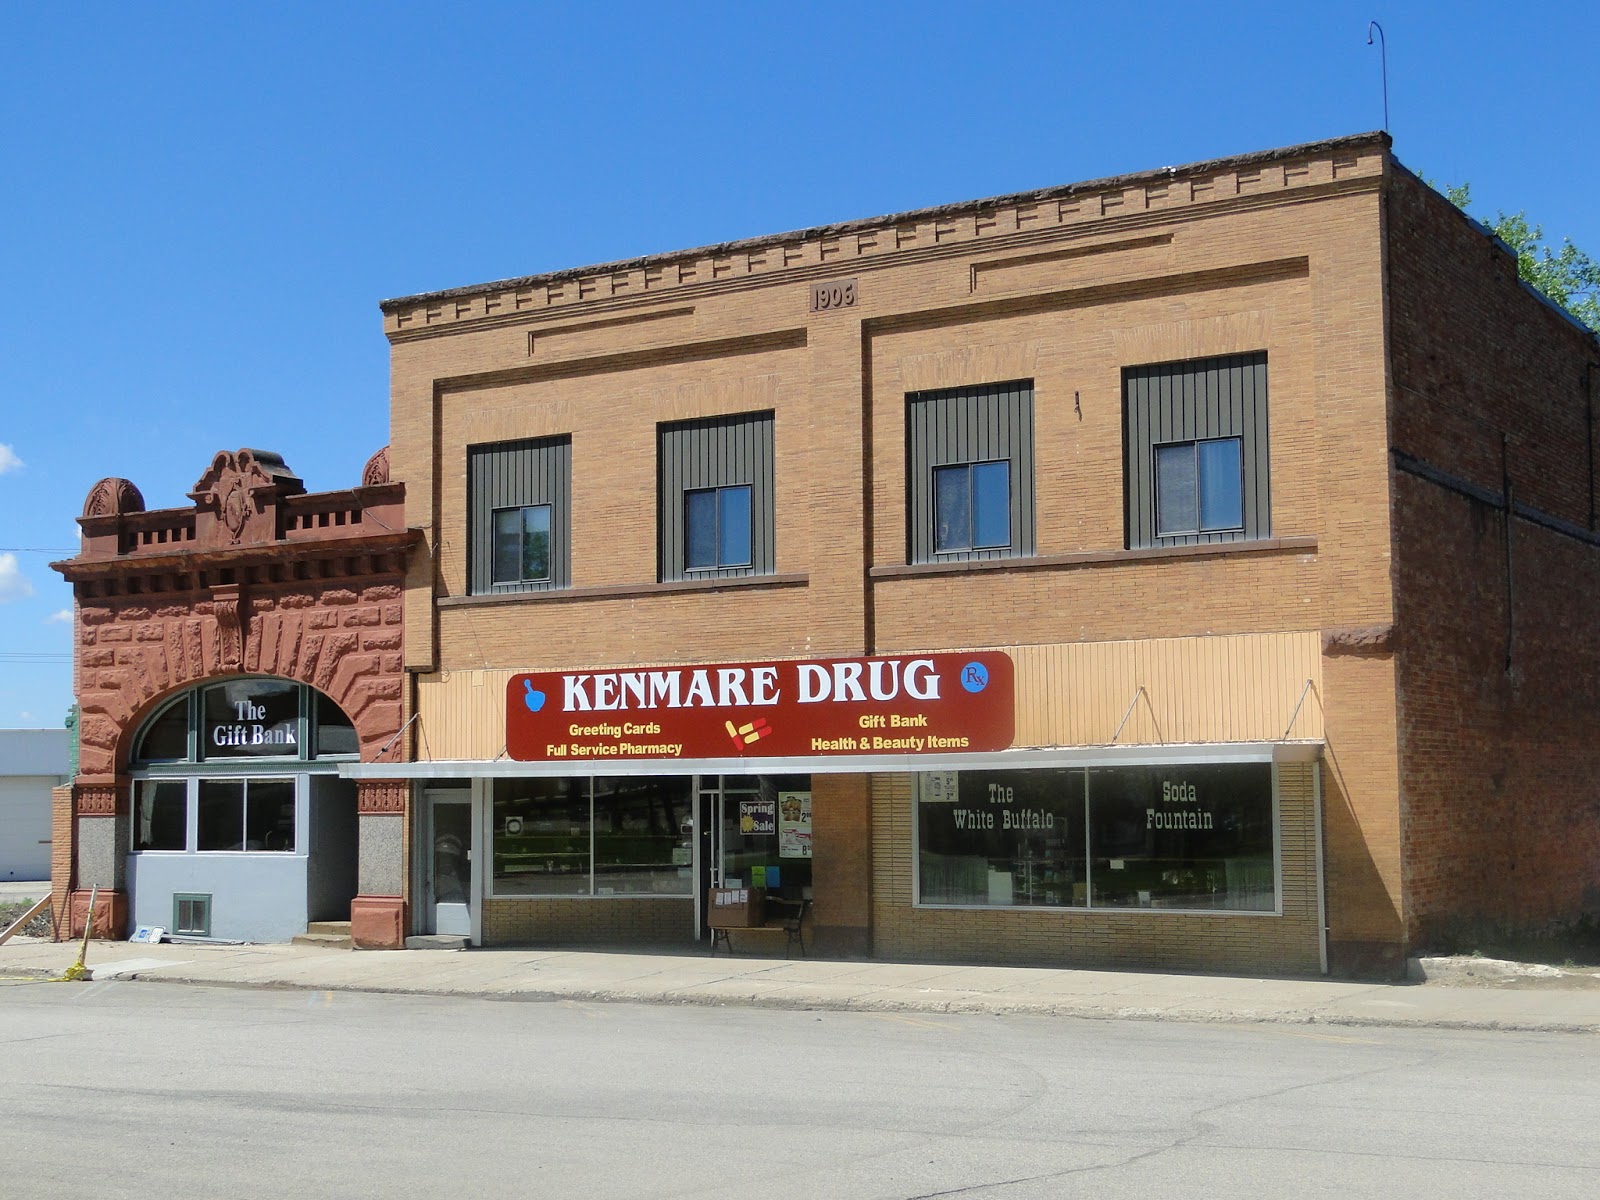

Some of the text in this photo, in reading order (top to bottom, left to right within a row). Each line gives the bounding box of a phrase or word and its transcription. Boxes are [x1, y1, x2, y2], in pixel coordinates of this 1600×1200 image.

[813, 284, 855, 310] 1906
[562, 659, 941, 712] KENMARE DRUG
[234, 700, 267, 721] The
[858, 713, 928, 729] Gift Bank
[213, 724, 297, 746] Gift Bank
[569, 722, 661, 738] Greeting Cards
[546, 742, 683, 757] Full Service Pharmacy
[811, 735, 970, 752] Health & Beauty Items
[988, 783, 1014, 804] The
[1162, 780, 1197, 803] Soda
[741, 803, 774, 816] Spring
[953, 808, 1055, 831] White Buffalo
[1146, 807, 1214, 831] Fountain
[753, 820, 774, 832] Sale
